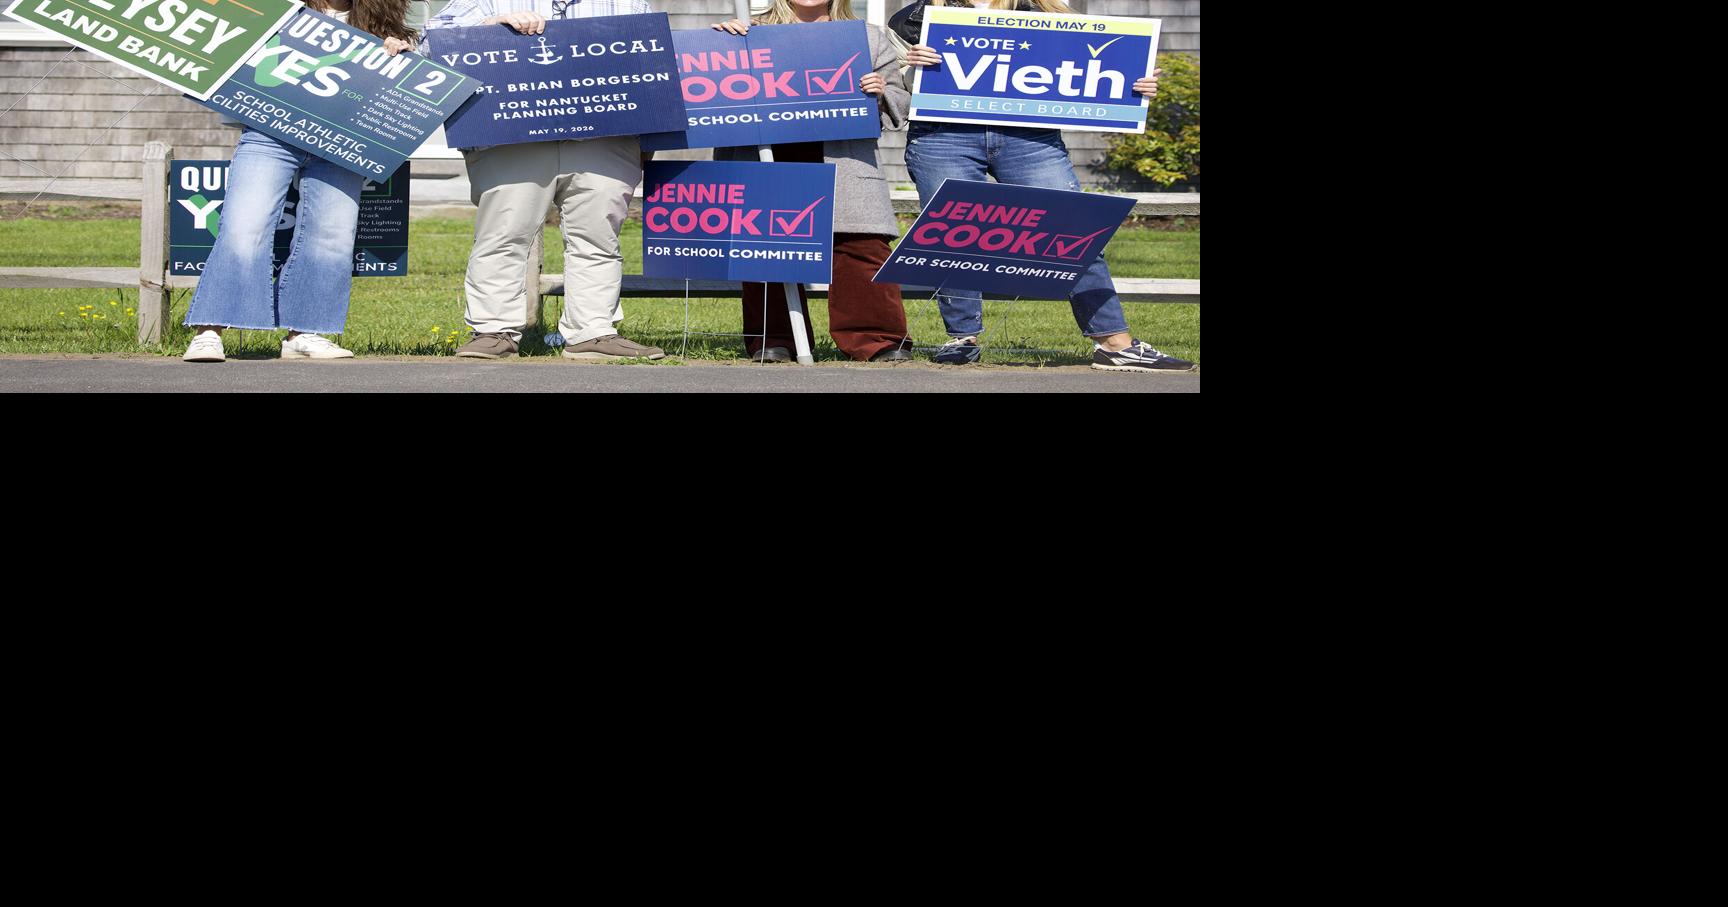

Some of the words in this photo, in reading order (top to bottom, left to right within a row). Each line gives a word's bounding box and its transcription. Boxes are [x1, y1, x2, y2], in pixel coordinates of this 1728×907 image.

[86, 0, 247, 55] YSEY
[977, 16, 1051, 29] ELECTION
[1055, 21, 1087, 31] MAY
[1092, 23, 1106, 32] 19
[33, 0, 119, 43] LAND
[117, 35, 209, 82] BANK
[279, 13, 412, 80] UESTION
[414, 70, 447, 95] 2
[442, 49, 518, 67] VOTE
[569, 39, 664, 58] LOCAL
[961, 37, 1016, 51] VOTE
[246, 43, 351, 97] YES
[342, 88, 364, 102] FOR
[675, 48, 774, 73] NNIE
[475, 86, 500, 94] PT.
[507, 80, 563, 93] BRIAN
[571, 72, 670, 88] BORGESON
[680, 71, 800, 103] OOK
[942, 52, 1126, 99] Vieth
[374, 101, 393, 113] 400m
[393, 109, 412, 121] Track
[379, 94, 412, 112] Multi-Use
[411, 108, 430, 119] Field
[386, 89, 402, 99] ADA
[403, 95, 444, 117] Grandstands
[493, 107, 577, 120] PLANNING
[584, 102, 638, 115] BOARD
[499, 100, 530, 110] FOR
[536, 93, 628, 108] NANTUCKET
[950, 99, 1027, 113] SELECT
[1037, 104, 1108, 118] BOARD
[233, 91, 291, 122] SCHOOL
[294, 118, 367, 153] ATHLETIC
[356, 119, 375, 131] Team
[373, 127, 397, 141] Rooms
[361, 113, 383, 126] Public
[382, 122, 417, 141] Restrooms
[367, 107, 385, 118] Dark
[384, 114, 398, 124] Sky
[397, 120, 425, 136] Lighting
[528, 128, 549, 136] MAY
[554, 126, 567, 135] 19,
[570, 125, 594, 133] 2026
[688, 113, 763, 127] SCHOOL
[768, 107, 868, 122] COMMITTEE
[208, 95, 270, 124] CILITIES
[269, 119, 386, 175] IMPROVEMENTS
[646, 183, 746, 205] JENNIE
[645, 206, 762, 236] COOK
[928, 200, 1047, 228] JENNIE
[912, 221, 1049, 256] COOK
[647, 246, 671, 256] FOR
[674, 247, 725, 258] SCHOOL
[729, 248, 823, 262] COMMITTEE
[895, 255, 926, 267] FOR
[929, 258, 990, 272] SCHOOL
[994, 264, 1078, 281] COMMITTEE
